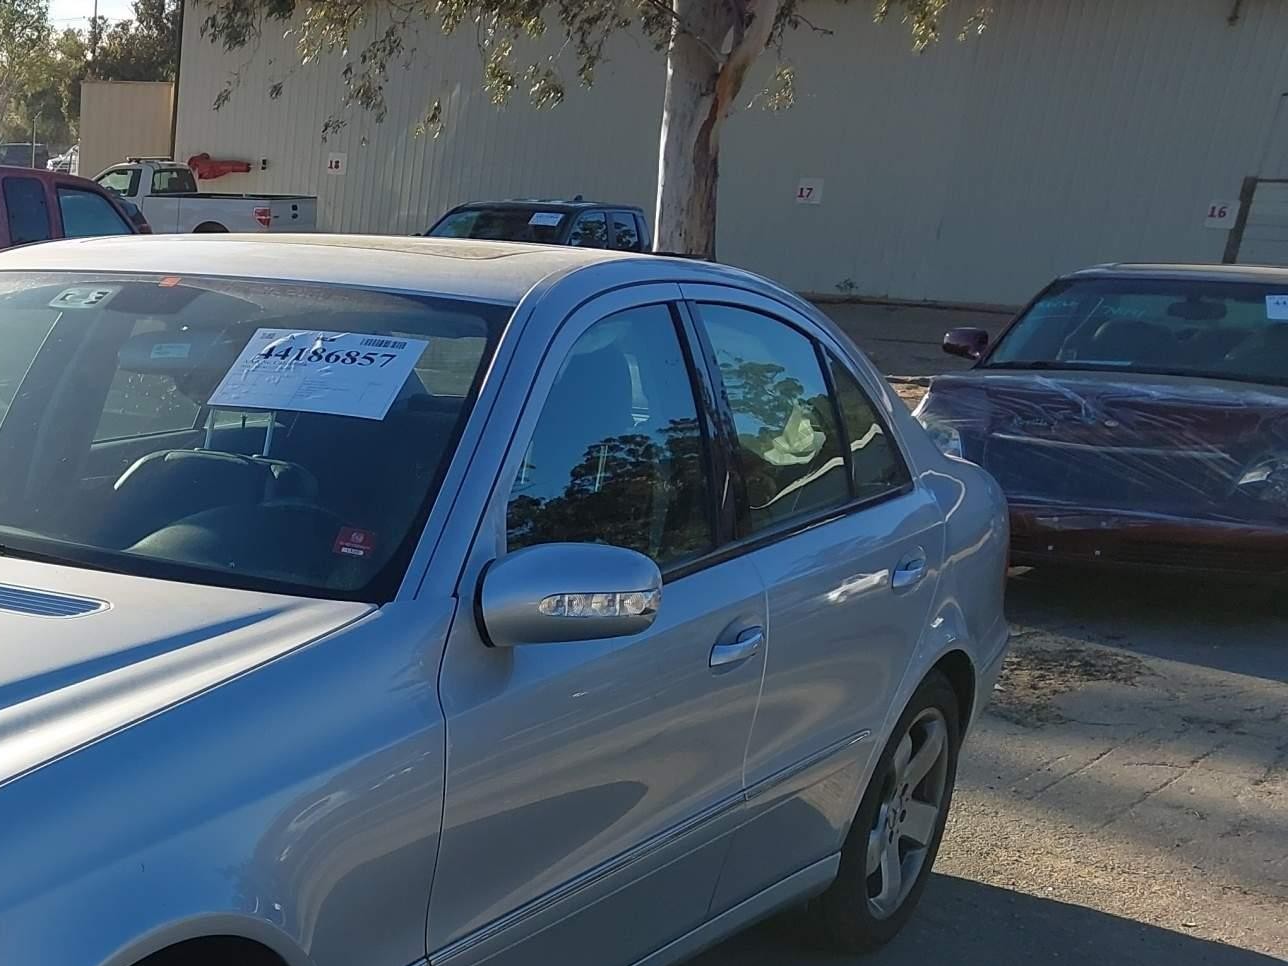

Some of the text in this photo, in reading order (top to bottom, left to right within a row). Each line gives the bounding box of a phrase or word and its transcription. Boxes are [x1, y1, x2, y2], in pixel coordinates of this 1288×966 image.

[797, 187, 813, 198] 17
[1208, 206, 1228, 218] 16
[258, 345, 397, 368] 44186857
